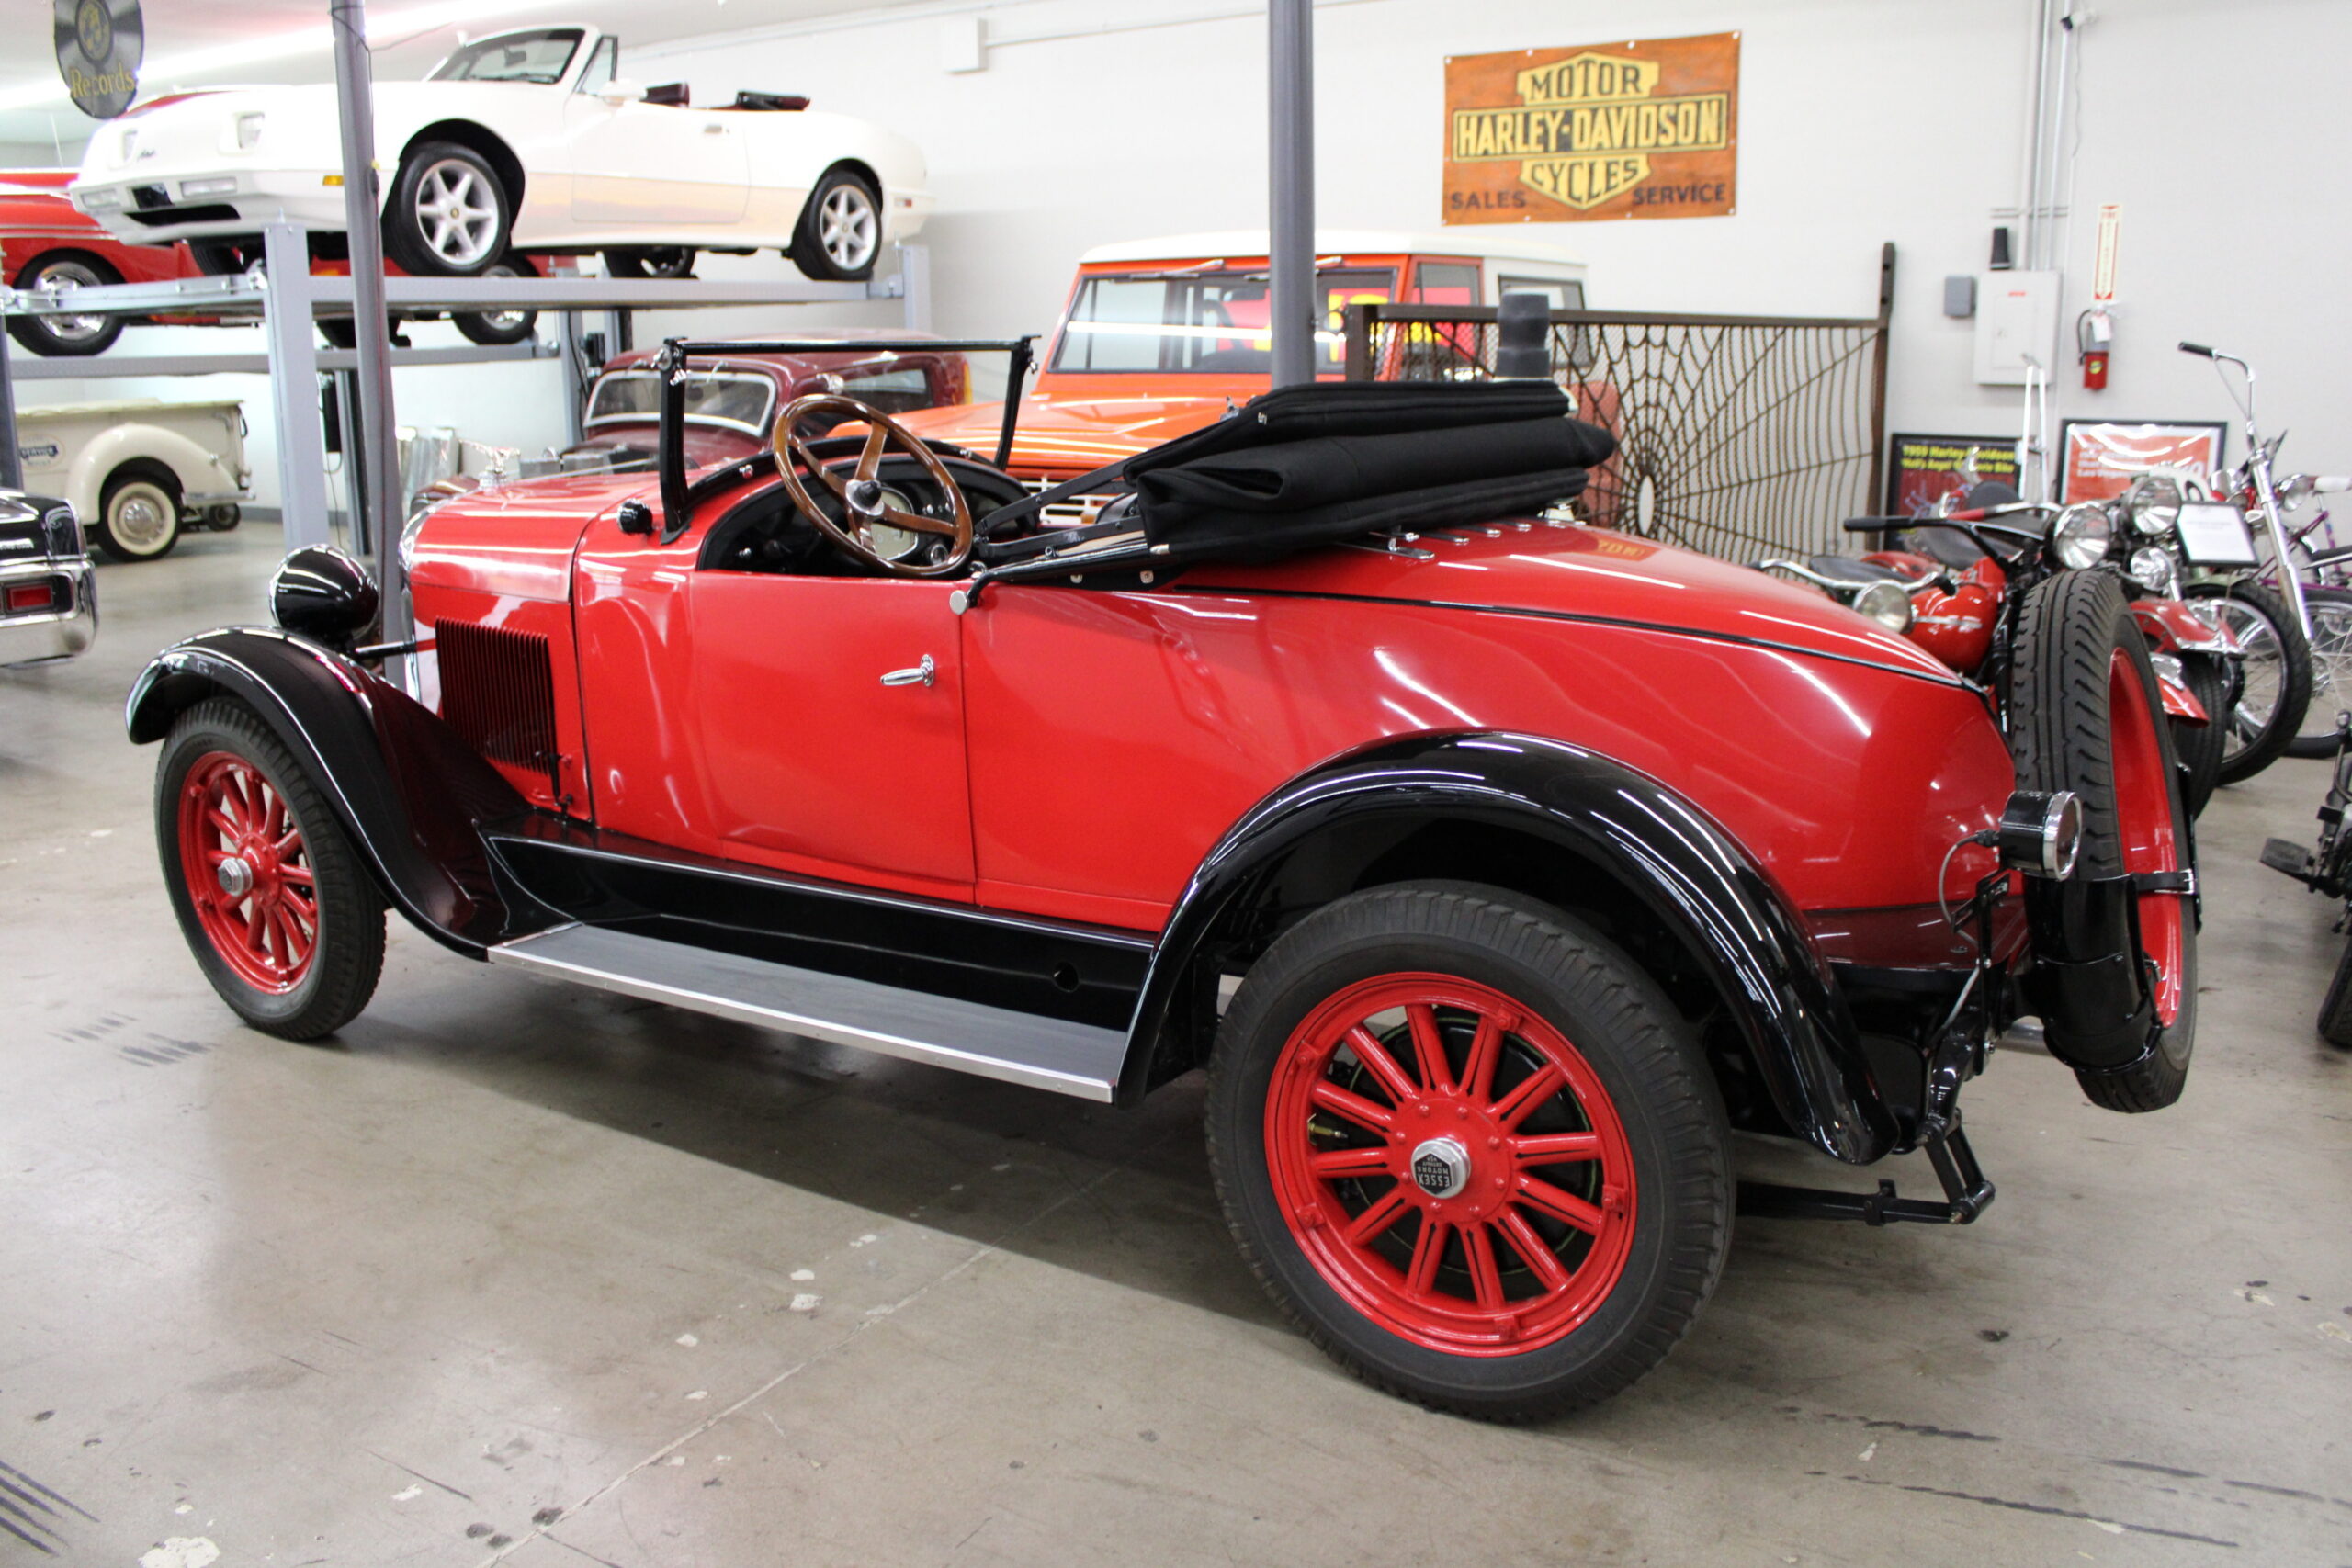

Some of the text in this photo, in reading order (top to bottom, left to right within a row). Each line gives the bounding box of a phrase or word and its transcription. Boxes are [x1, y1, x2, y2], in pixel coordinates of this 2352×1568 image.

[69, 62, 135, 97] Records
[1530, 59, 1642, 100] MOTOR
[1458, 98, 1720, 156] HARLEY-DAVIDSON
[1451, 184, 1725, 209] SALES SERVICE
[1531, 160, 1639, 203] CYCLES
[1418, 1174, 1451, 1187] ESSEX
